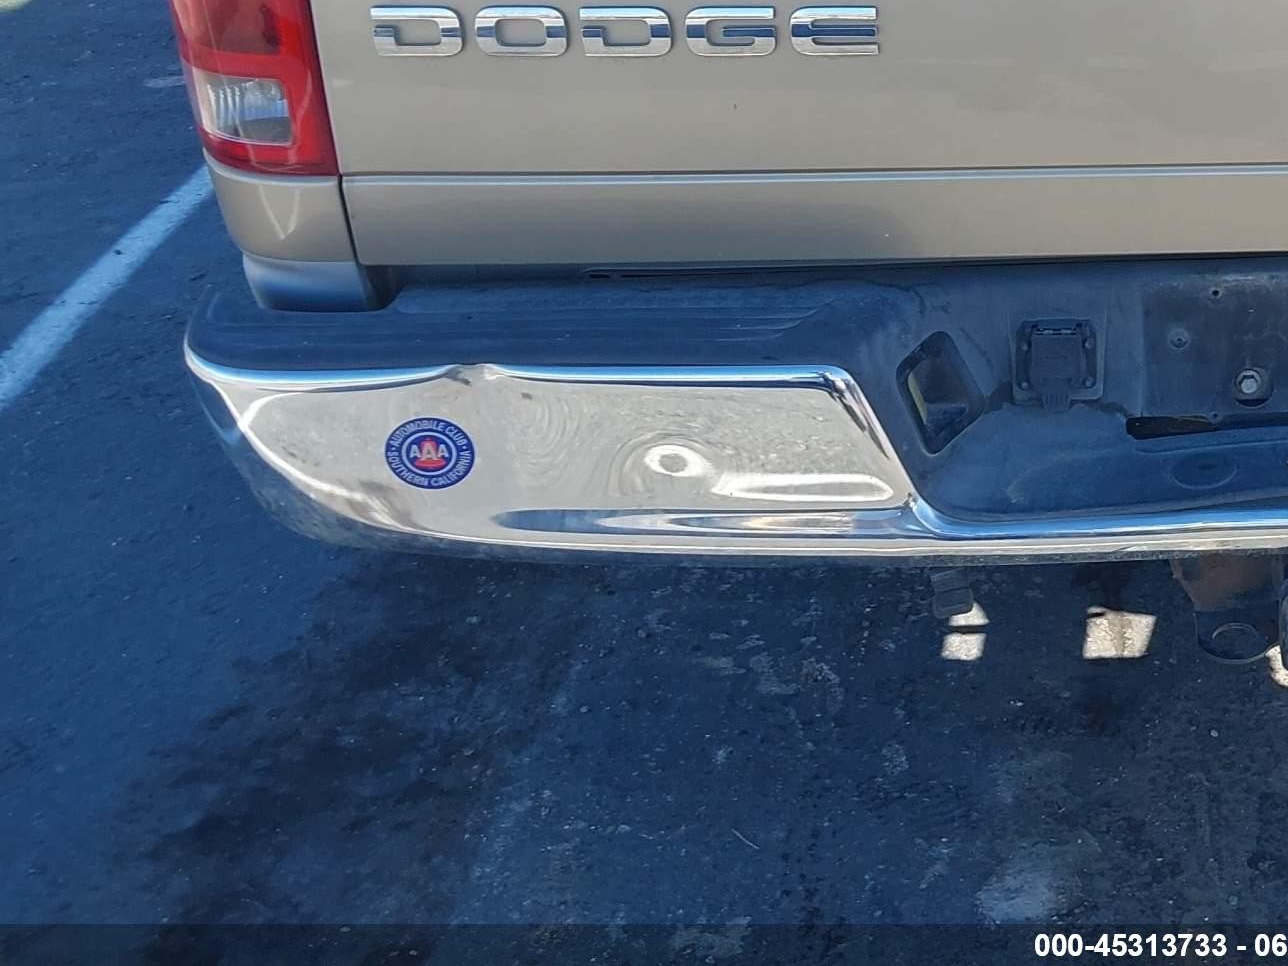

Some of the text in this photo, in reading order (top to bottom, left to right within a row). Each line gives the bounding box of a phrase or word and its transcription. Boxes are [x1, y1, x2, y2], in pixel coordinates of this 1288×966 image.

[370, 5, 879, 57] DODGE
[389, 419, 468, 447] AUTOMOBILE CLUB
[387, 450, 473, 486] SOUTHERN CALIFORNIA
[410, 444, 449, 461] AAA
